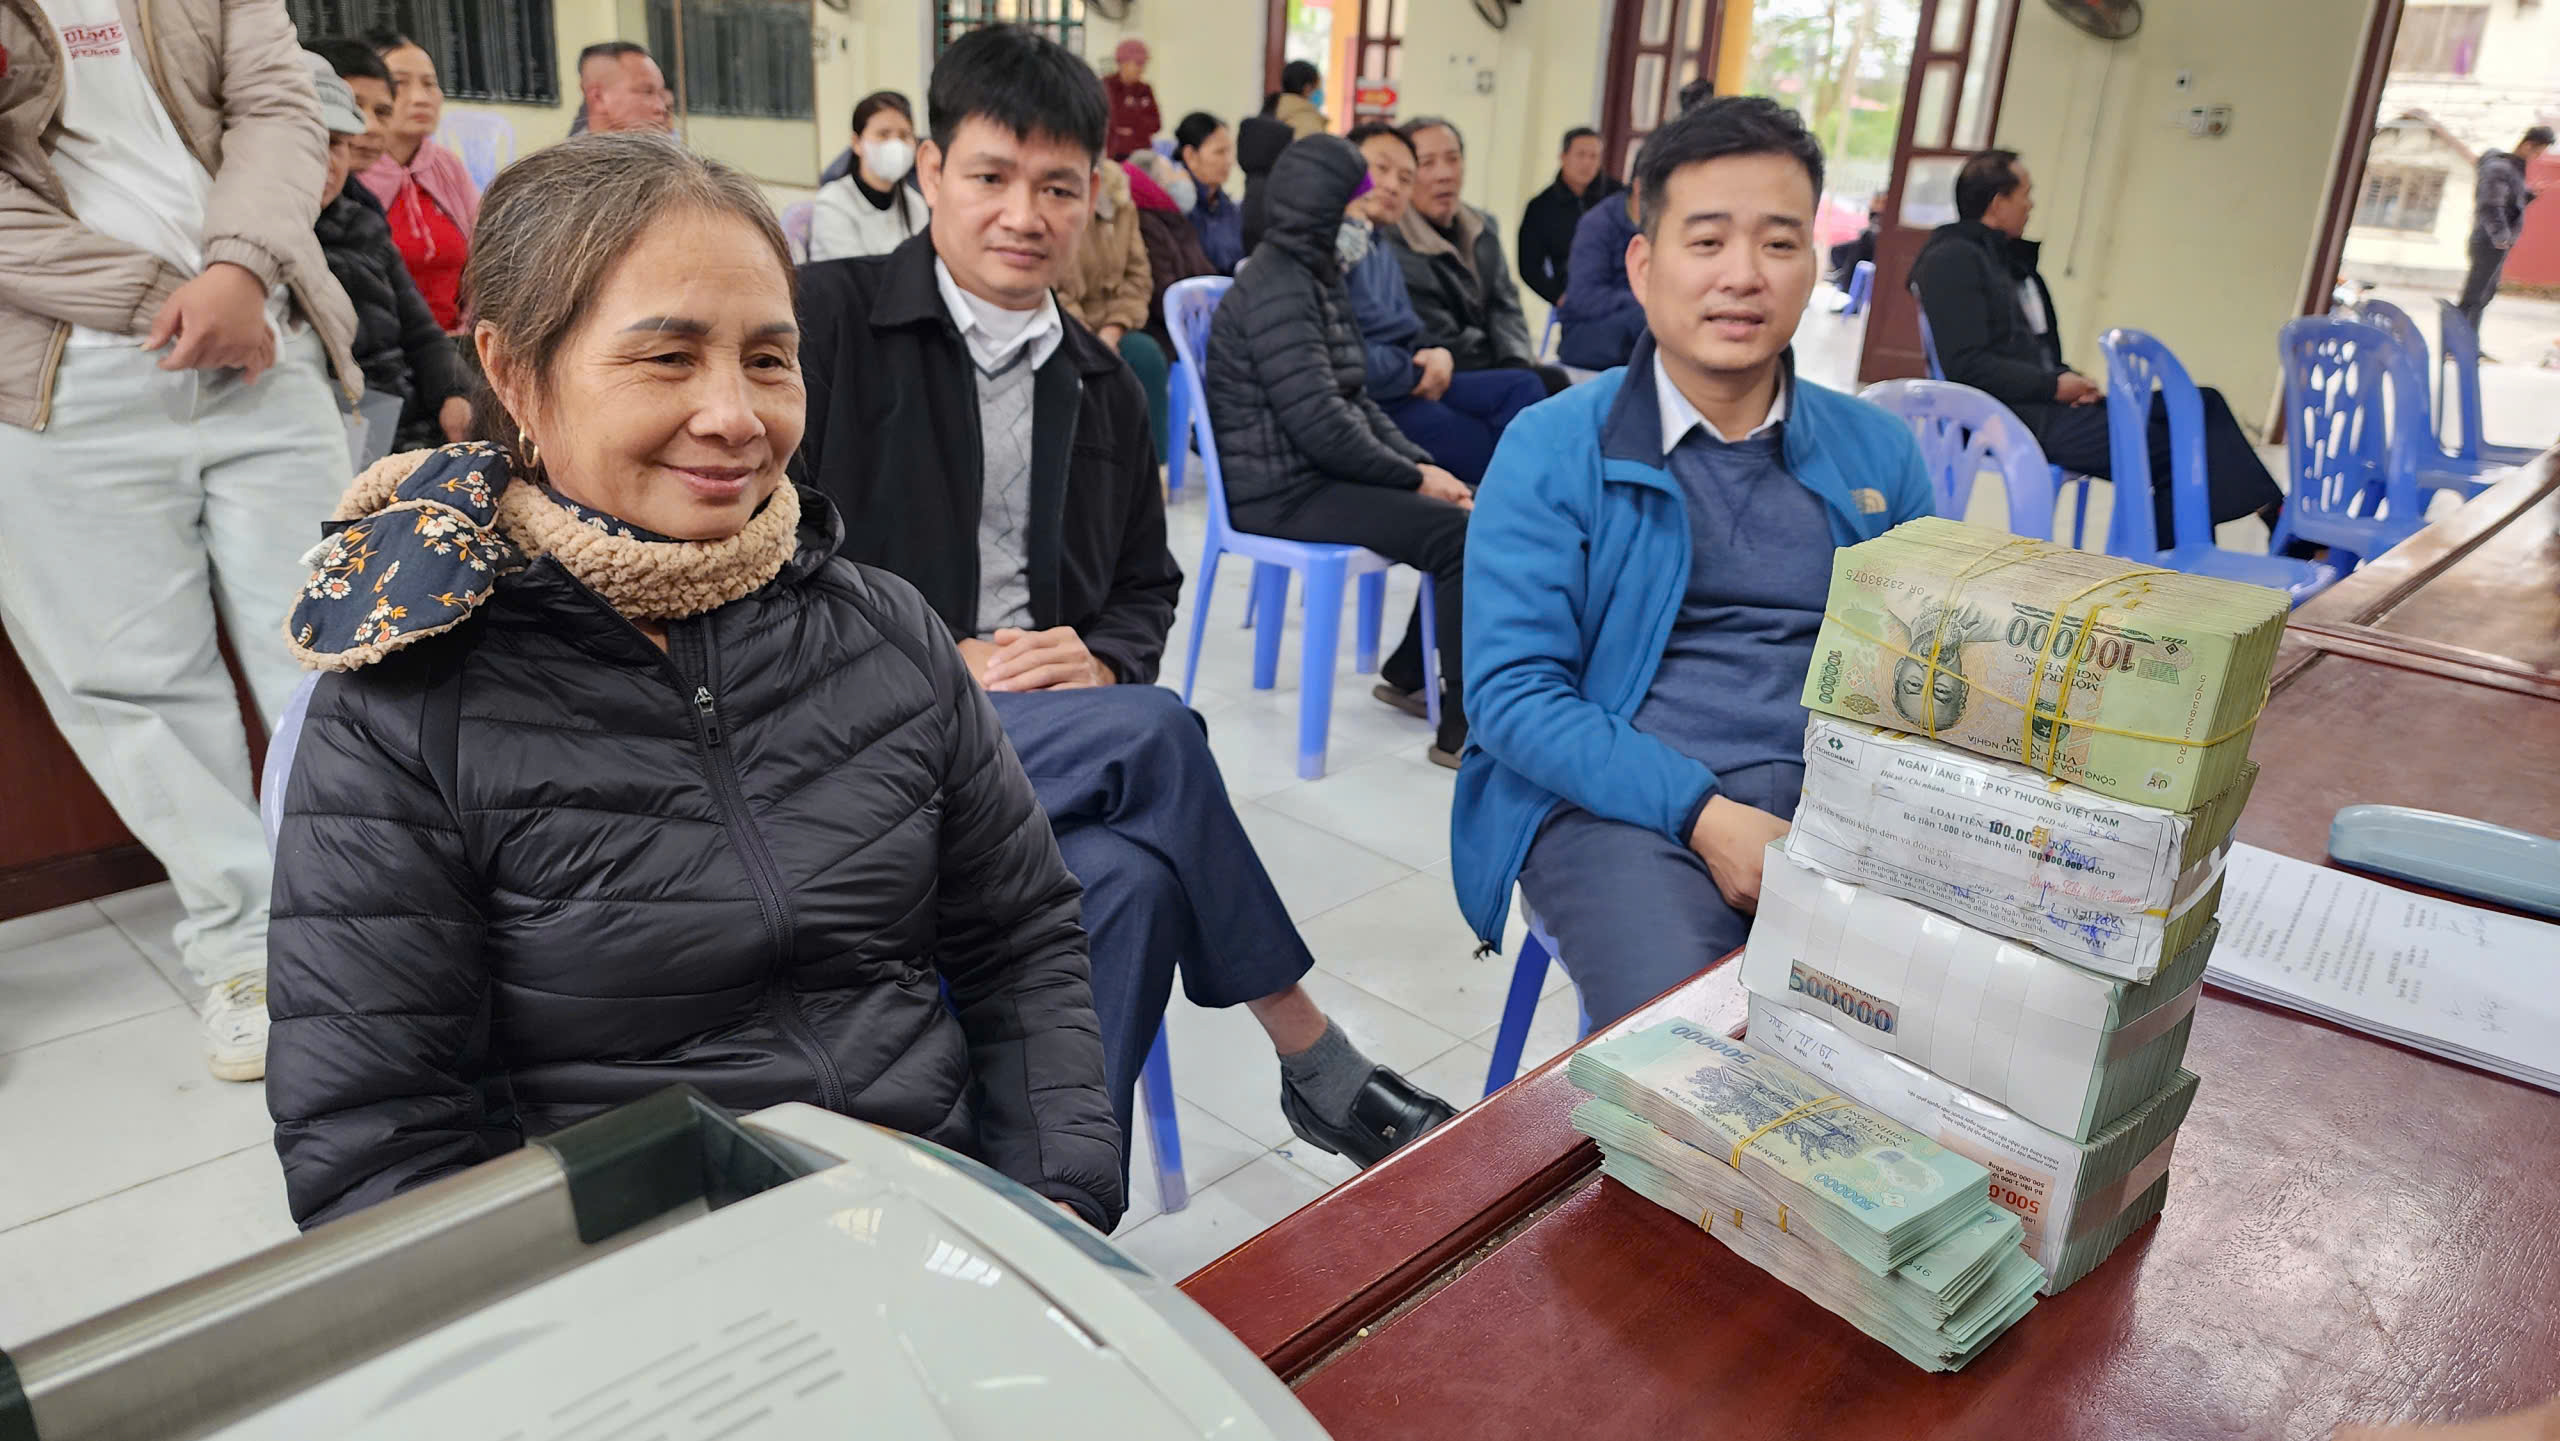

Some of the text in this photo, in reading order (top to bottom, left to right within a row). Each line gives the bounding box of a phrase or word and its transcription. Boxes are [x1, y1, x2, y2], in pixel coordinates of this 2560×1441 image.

[1846, 569, 1904, 590] 23283075
[2006, 615, 2136, 673] 100000
[1819, 650, 1842, 704] 100000
[1815, 746, 1855, 766] TECHCOMBANK
[2092, 813, 2120, 828] NAM
[1938, 822, 1960, 835] 1.000
[2028, 849, 2083, 870] 100.000.000
[1788, 966, 1894, 1033] 500000
[1670, 1026, 1756, 1064] 500000
[1814, 1172, 1881, 1211] 500000
[2000, 1175, 2018, 1186] 1.000
[2005, 1169, 2046, 1189] 500.000.000
